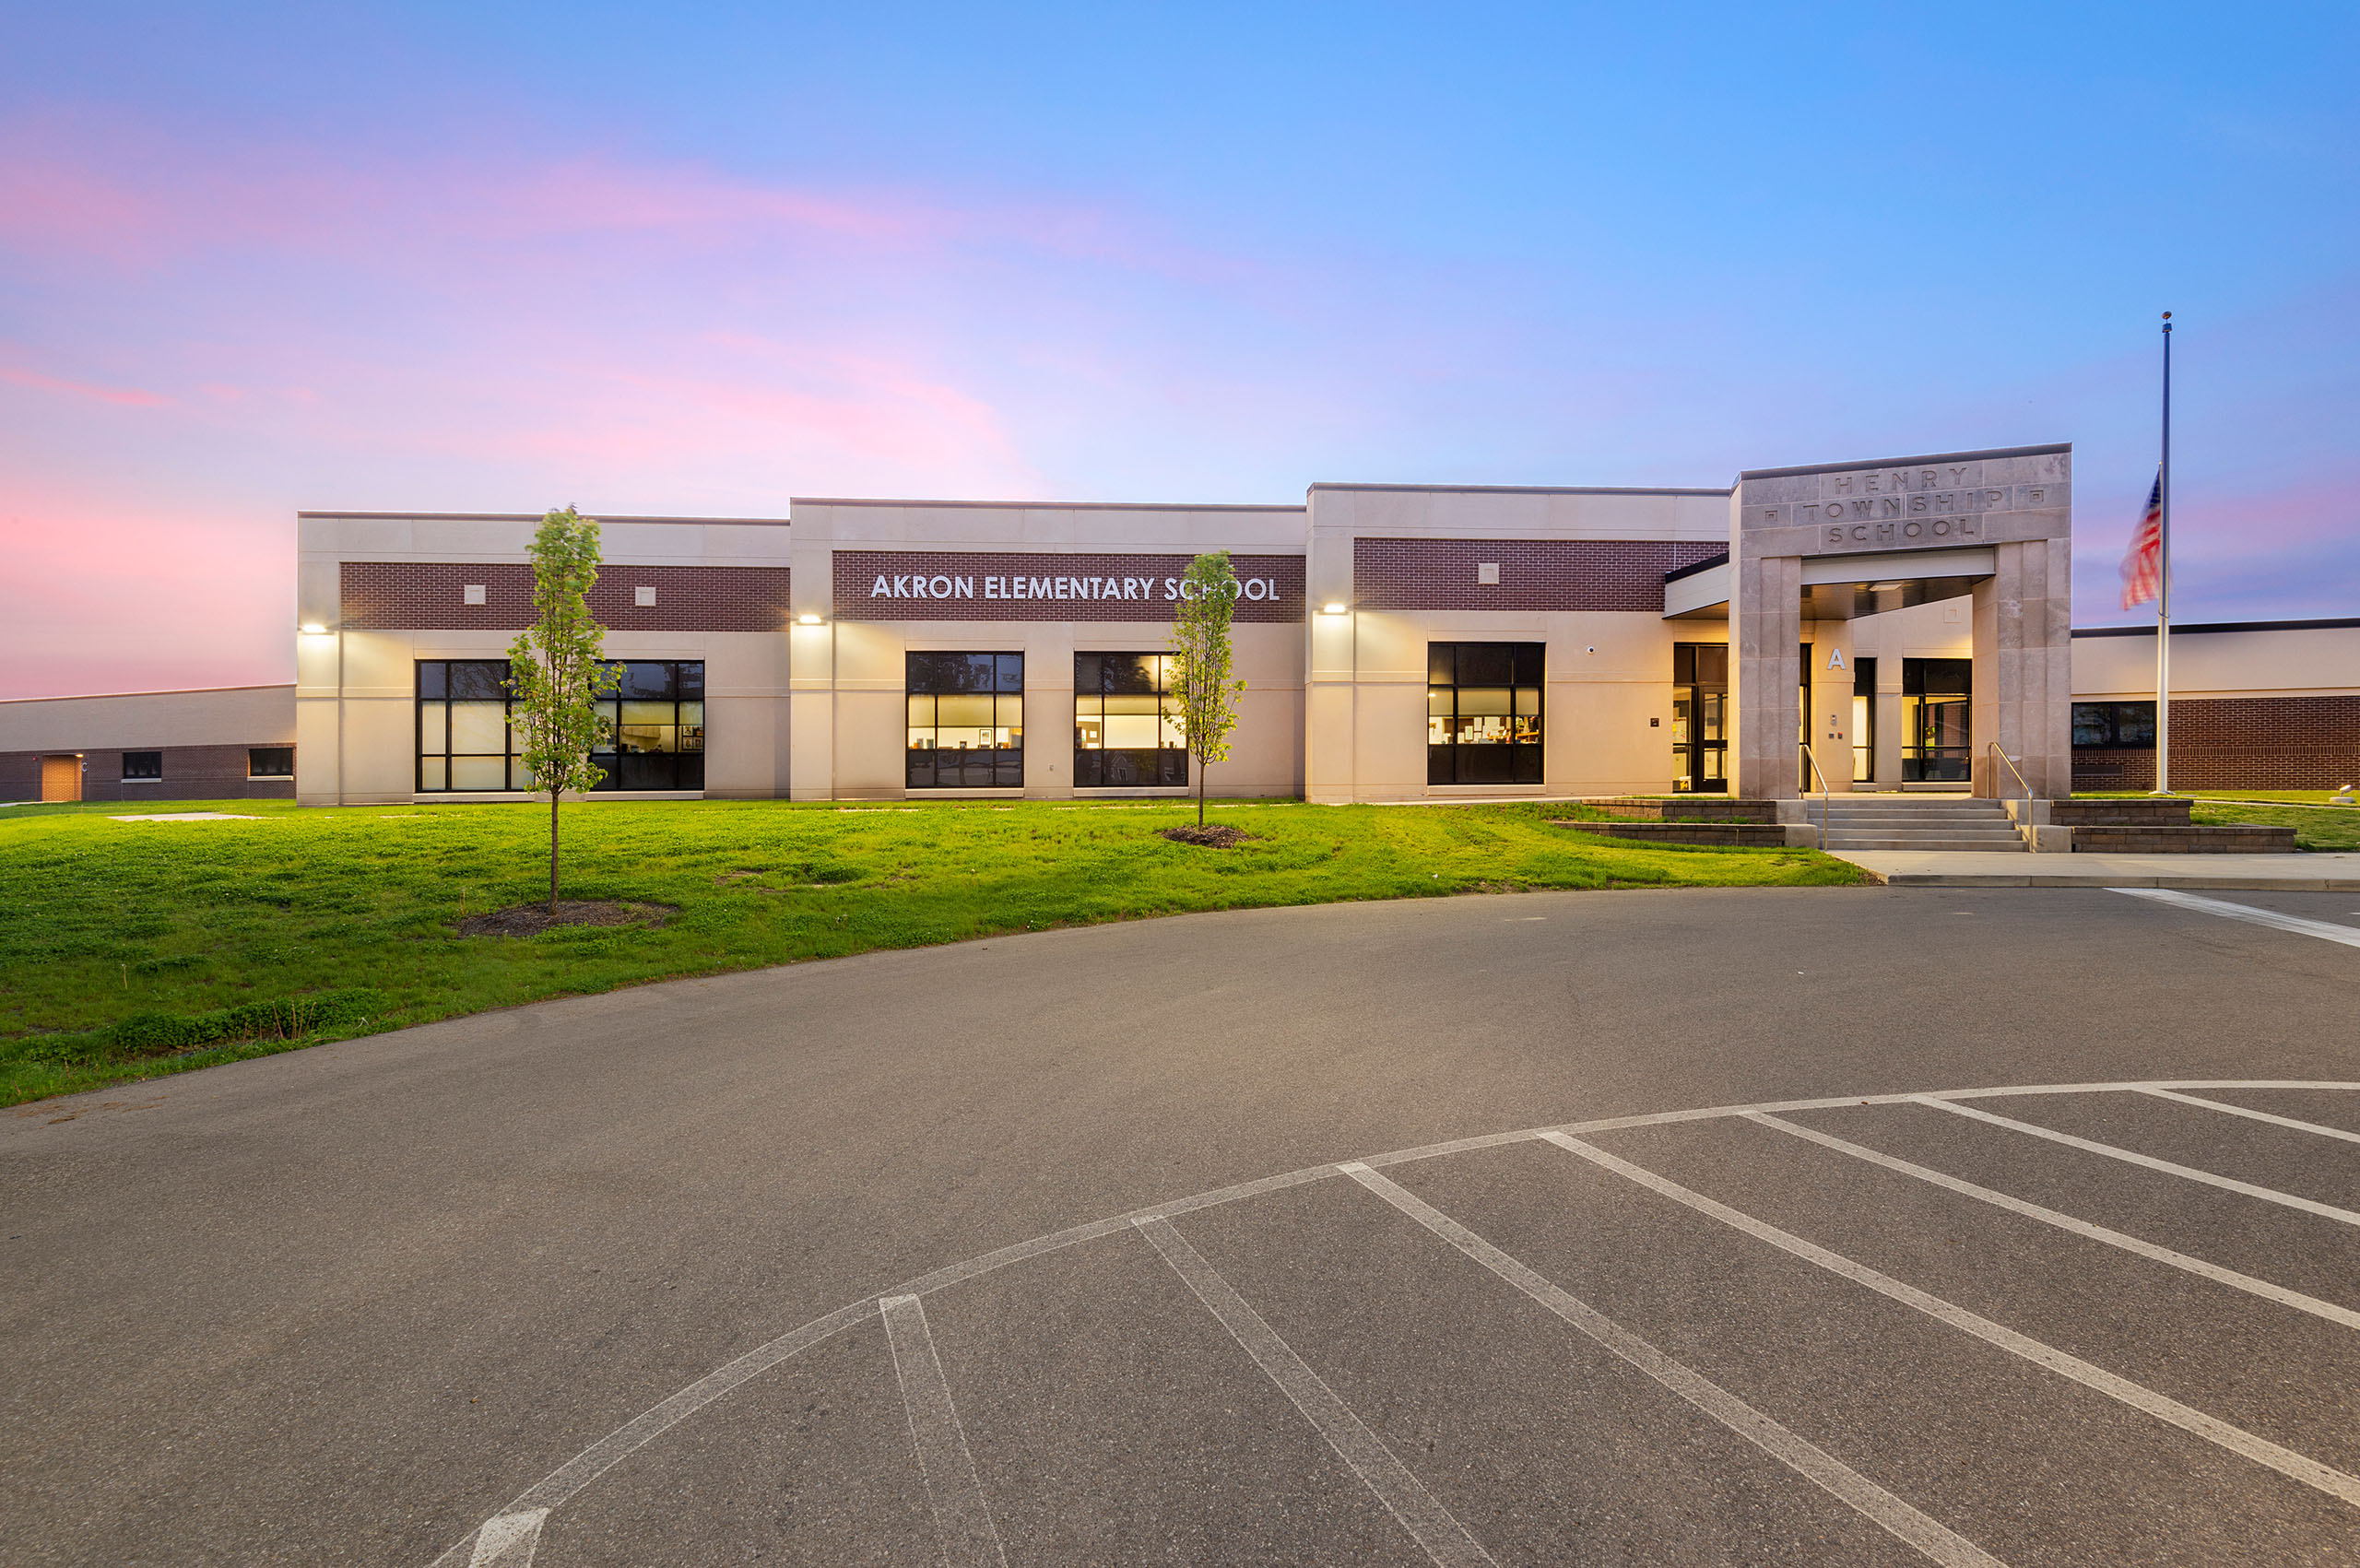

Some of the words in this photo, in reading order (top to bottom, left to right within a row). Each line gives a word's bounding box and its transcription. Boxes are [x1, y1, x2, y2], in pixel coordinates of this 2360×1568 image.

[1835, 467, 1967, 494] HENRY
[1803, 490, 2003, 521] TOWNSHIP
[1829, 519, 1974, 542] SCHOOL
[870, 575, 974, 599] AKRON
[985, 576, 1155, 600] ELEMENTARY
[1827, 648, 1846, 669] A
